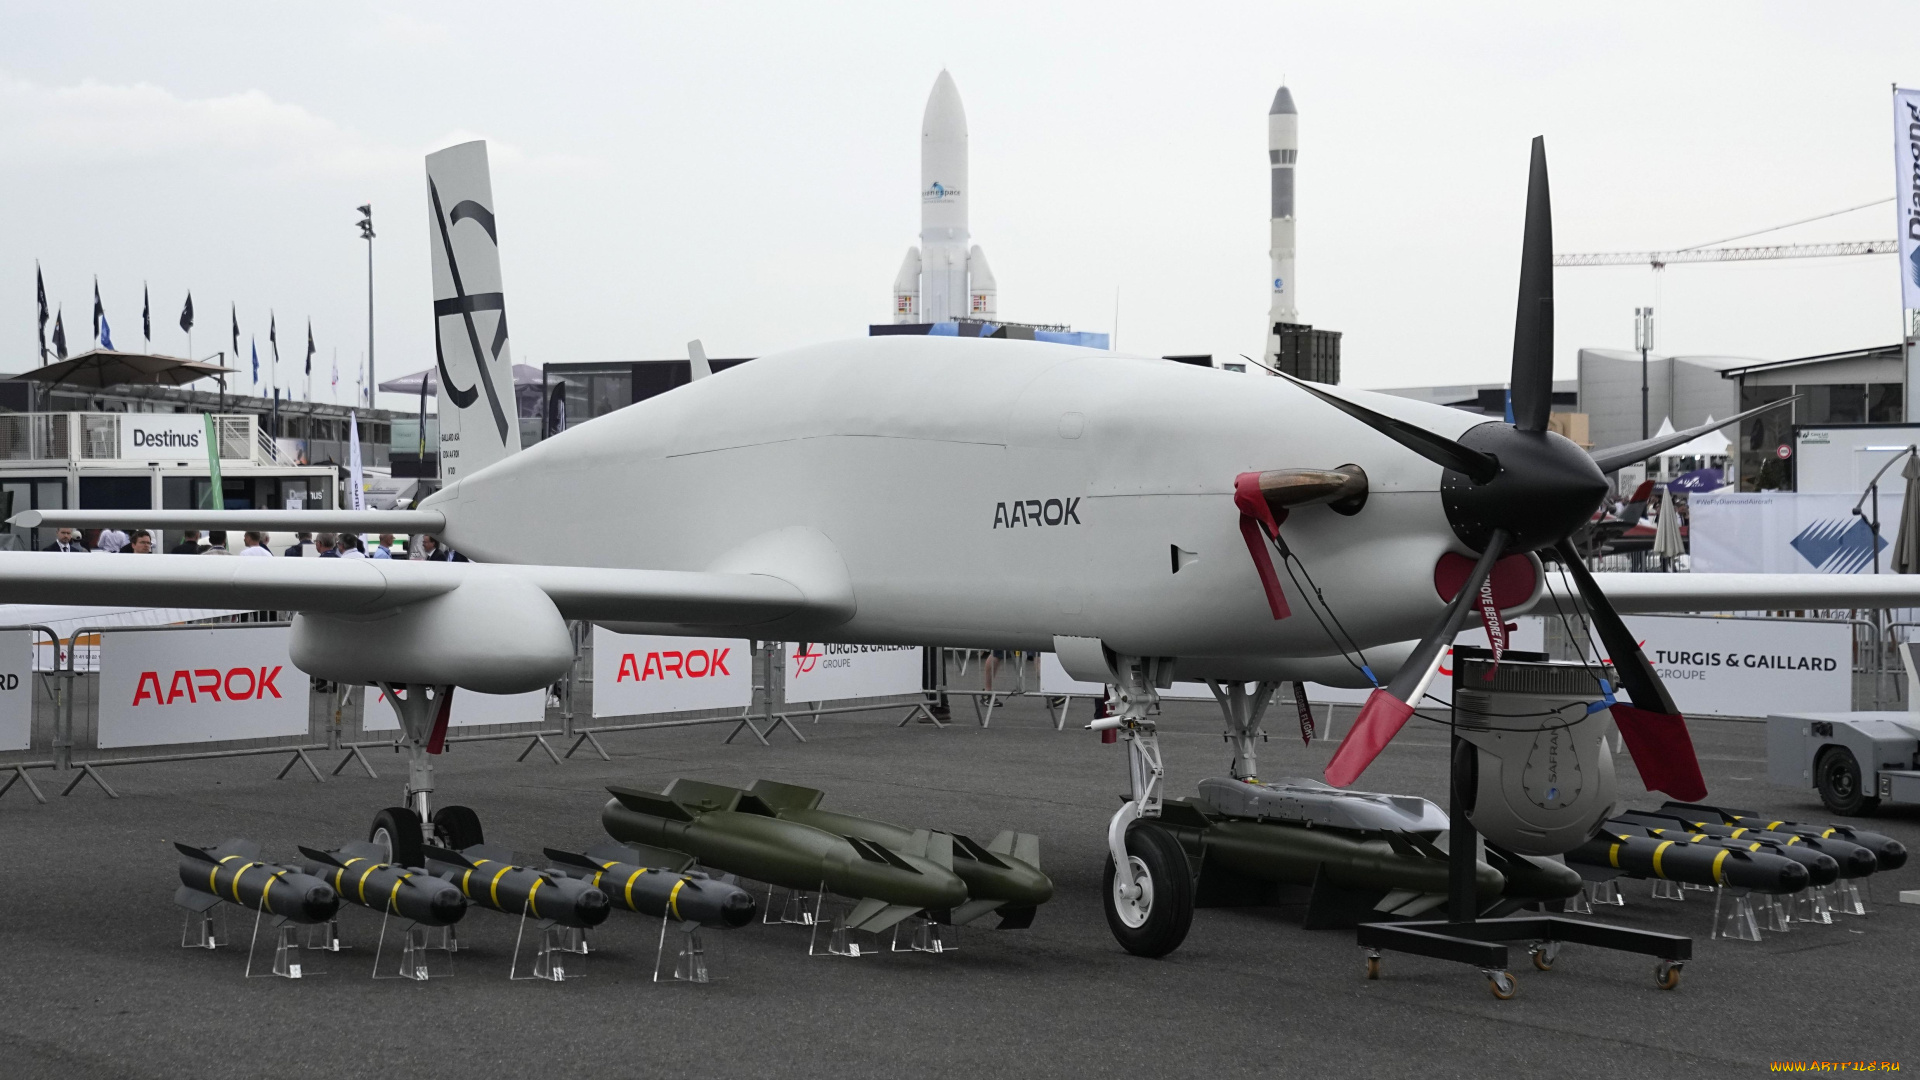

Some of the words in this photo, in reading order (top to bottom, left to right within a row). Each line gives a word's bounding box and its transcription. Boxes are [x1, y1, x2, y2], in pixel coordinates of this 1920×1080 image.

[993, 497, 1081, 529] AAROK
[1480, 574, 1494, 605] MOVE
[1483, 606, 1502, 637] BEFORE
[822, 658, 851, 669] GROUPE
[823, 643, 859, 655] TURGIS
[1656, 650, 1721, 667] TURGIS
[1725, 653, 1740, 667] &
[1744, 654, 1838, 672] GAILLARD
[617, 648, 731, 683] AAROK
[1656, 668, 1706, 680] GROUPE
[132, 666, 283, 706] AAROK
[1300, 713, 1313, 739] FLIGHT
[1548, 725, 1559, 784] SAFRAN
